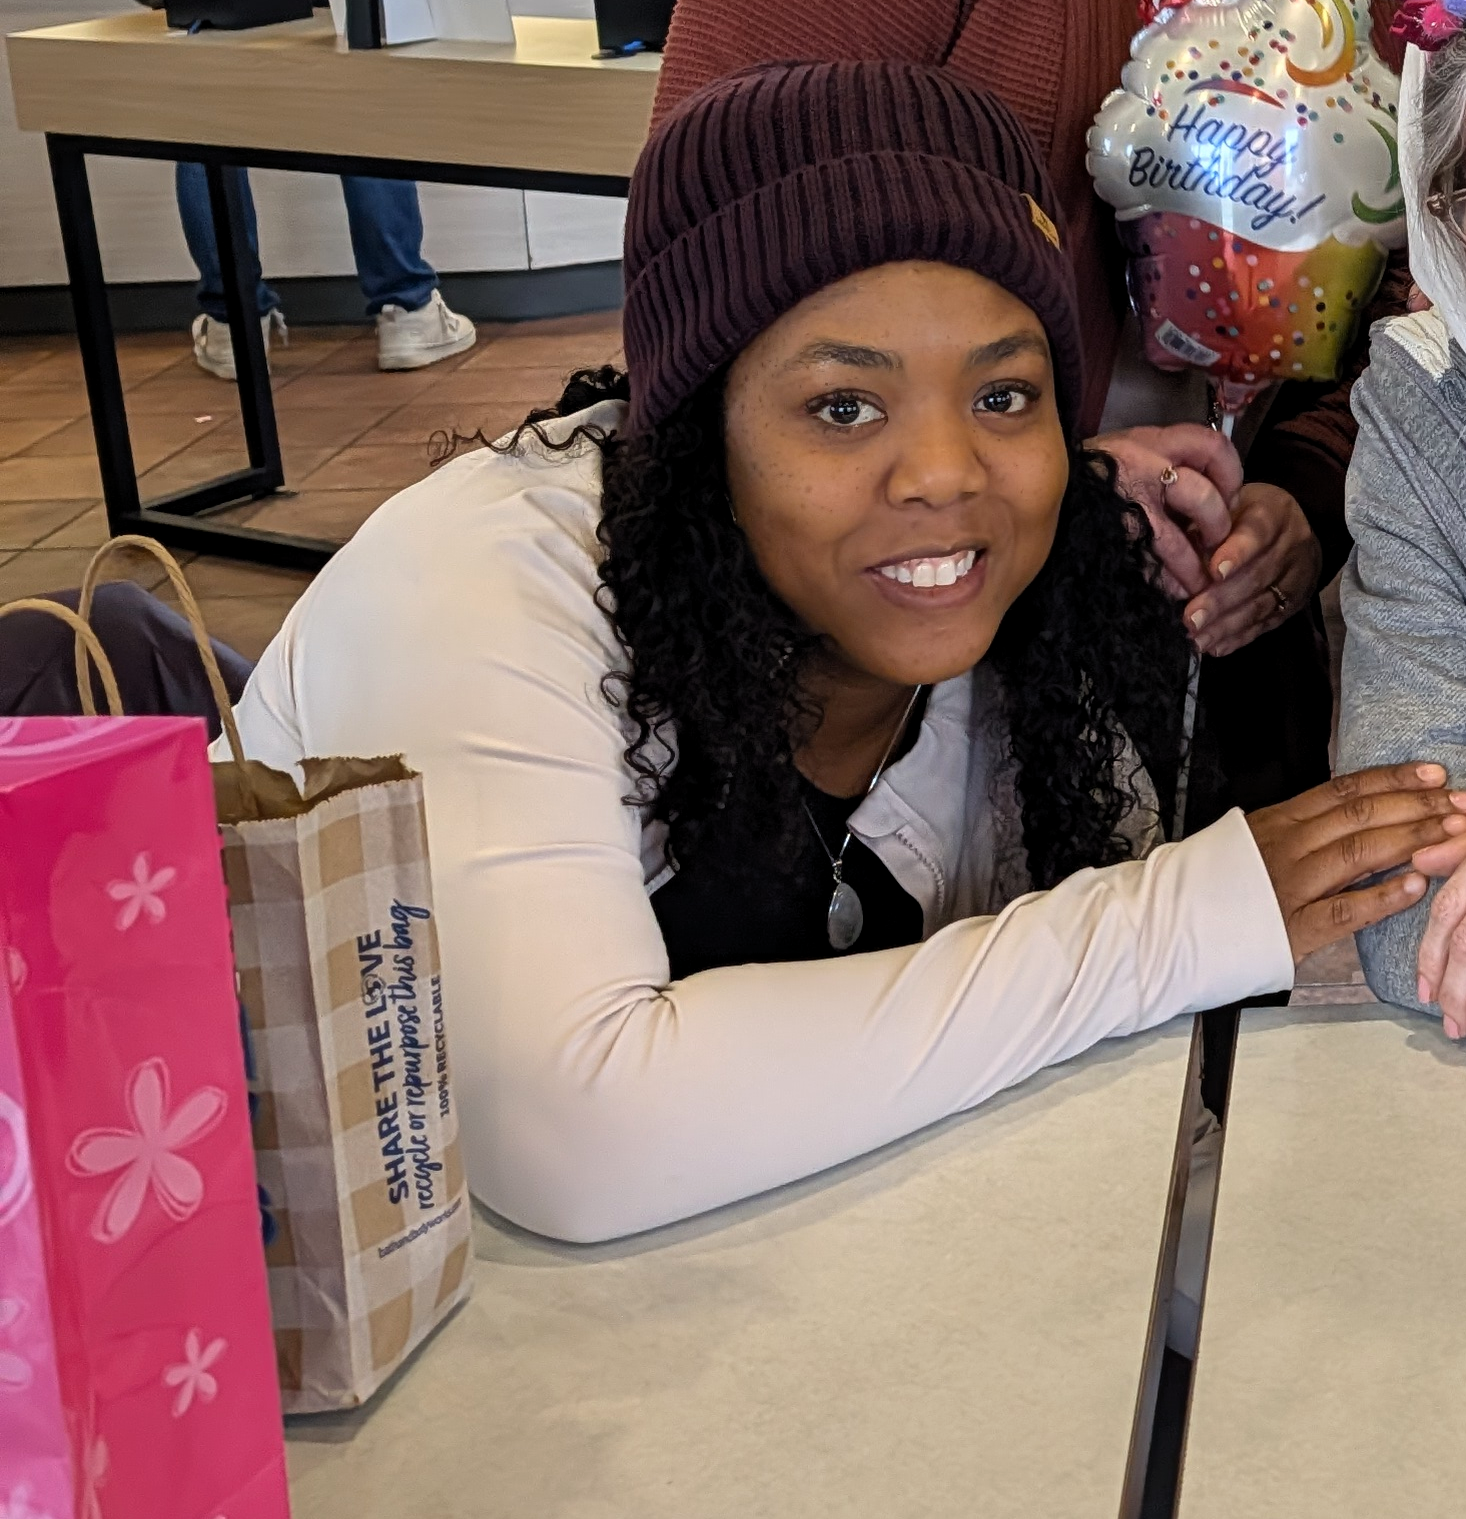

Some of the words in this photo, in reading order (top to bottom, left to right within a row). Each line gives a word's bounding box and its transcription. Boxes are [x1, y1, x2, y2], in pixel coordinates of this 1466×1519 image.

[1166, 103, 1297, 179] Happy
[1129, 146, 1326, 230] Birthday!
[382, 898, 431, 950] bag
[387, 954, 418, 1005] this
[367, 1020, 396, 1093] THE
[398, 1005, 432, 1106] repurpose
[431, 974, 448, 1074] RECYCLABLE
[376, 1091, 409, 1204] SHARE
[407, 1110, 426, 1131] or
[405, 1134, 443, 1209] recycle
